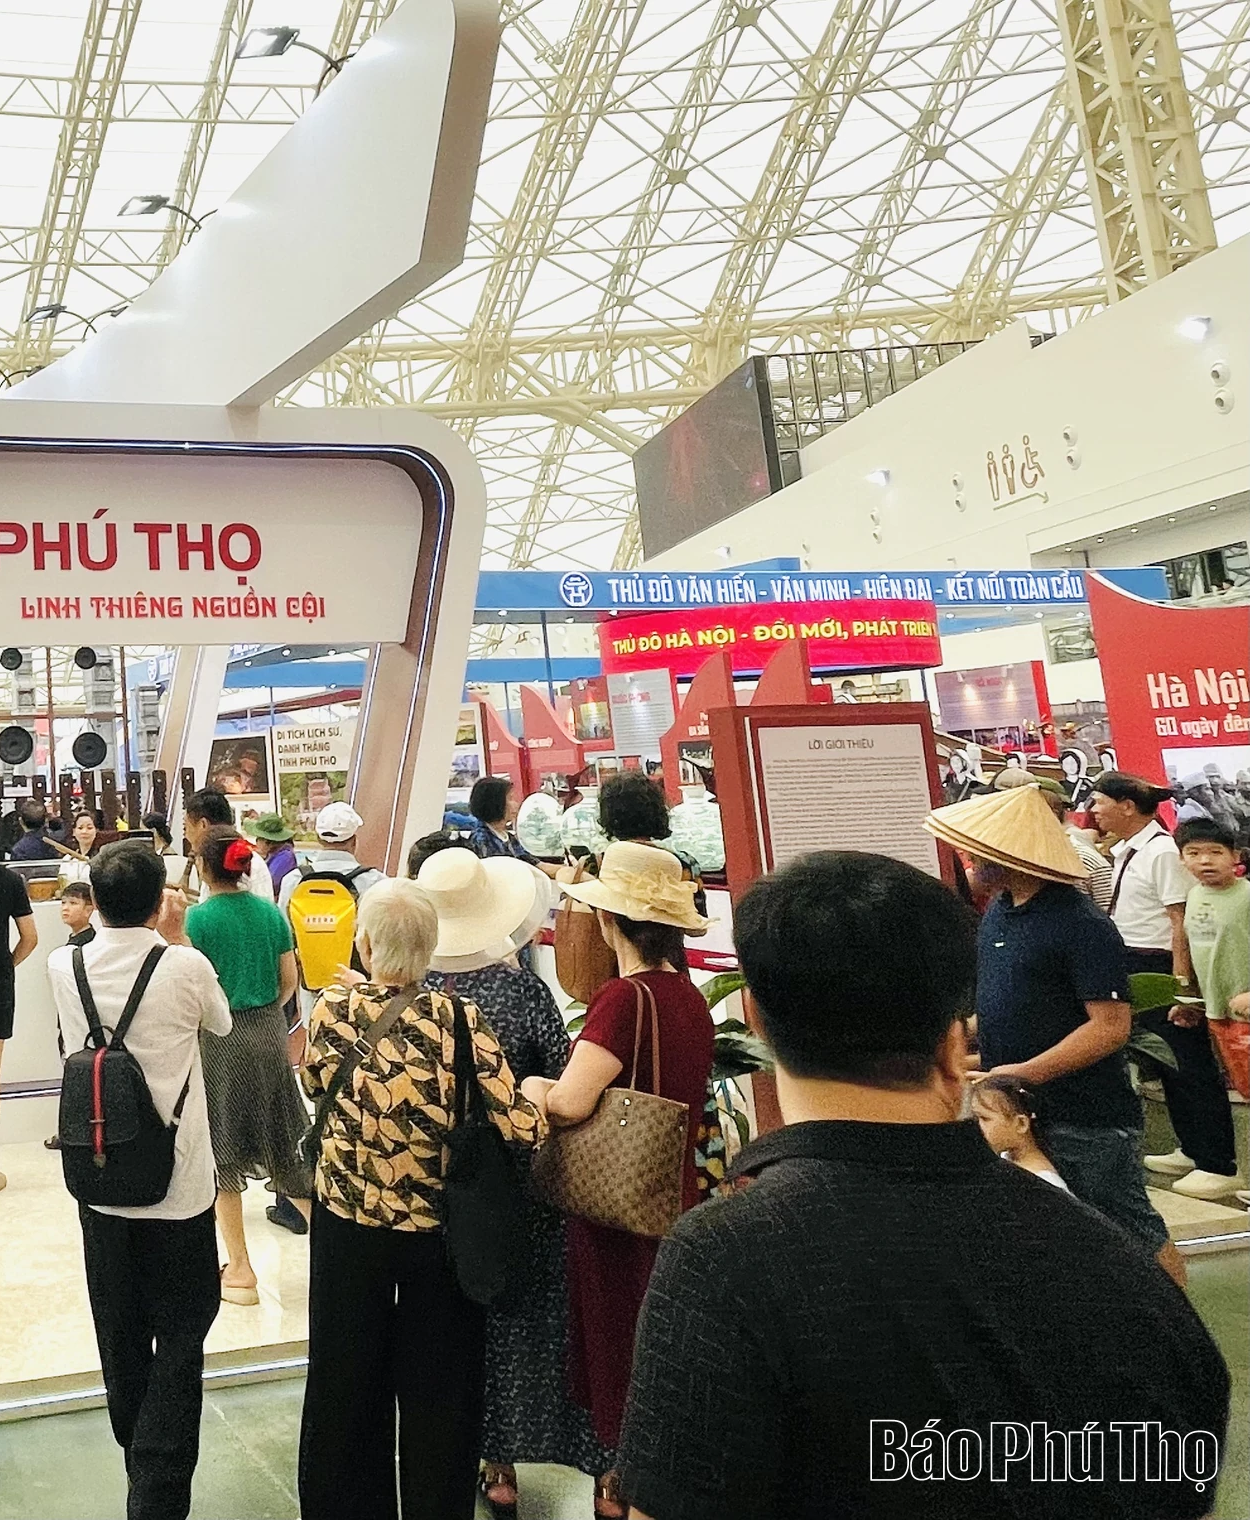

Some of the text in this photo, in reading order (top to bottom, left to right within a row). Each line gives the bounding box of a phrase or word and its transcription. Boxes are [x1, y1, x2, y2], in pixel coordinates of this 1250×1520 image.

[134, 523, 262, 586] THỌ
[21, 586, 326, 623] LINH THIÊNG NGUỒN CỘI
[608, 573, 644, 603] THỦ
[648, 575, 674, 603] ĐÔ
[677, 576, 713, 603] VĂN
[717, 572, 756, 603] HIẾN
[770, 576, 807, 602] VĂN
[810, 579, 850, 601] MINH
[946, 571, 974, 600] KẾT
[978, 572, 1005, 600] NỐI
[1007, 574, 1050, 600] TOÀN
[1051, 570, 1084, 598] CẦU
[613, 633, 636, 655] THỦ
[639, 632, 662, 652] ĐÔ
[666, 631, 693, 649] HÀ
[698, 624, 735, 649] NỘI
[754, 618, 795, 641] ĐỔI
[801, 617, 848, 641] MỚI,
[853, 616, 898, 637] PHÁT
[1146, 667, 1250, 711] Hà Nội
[1155, 716, 1178, 736] 60
[1181, 717, 1219, 738] ngày
[278, 743, 300, 754] DANH
